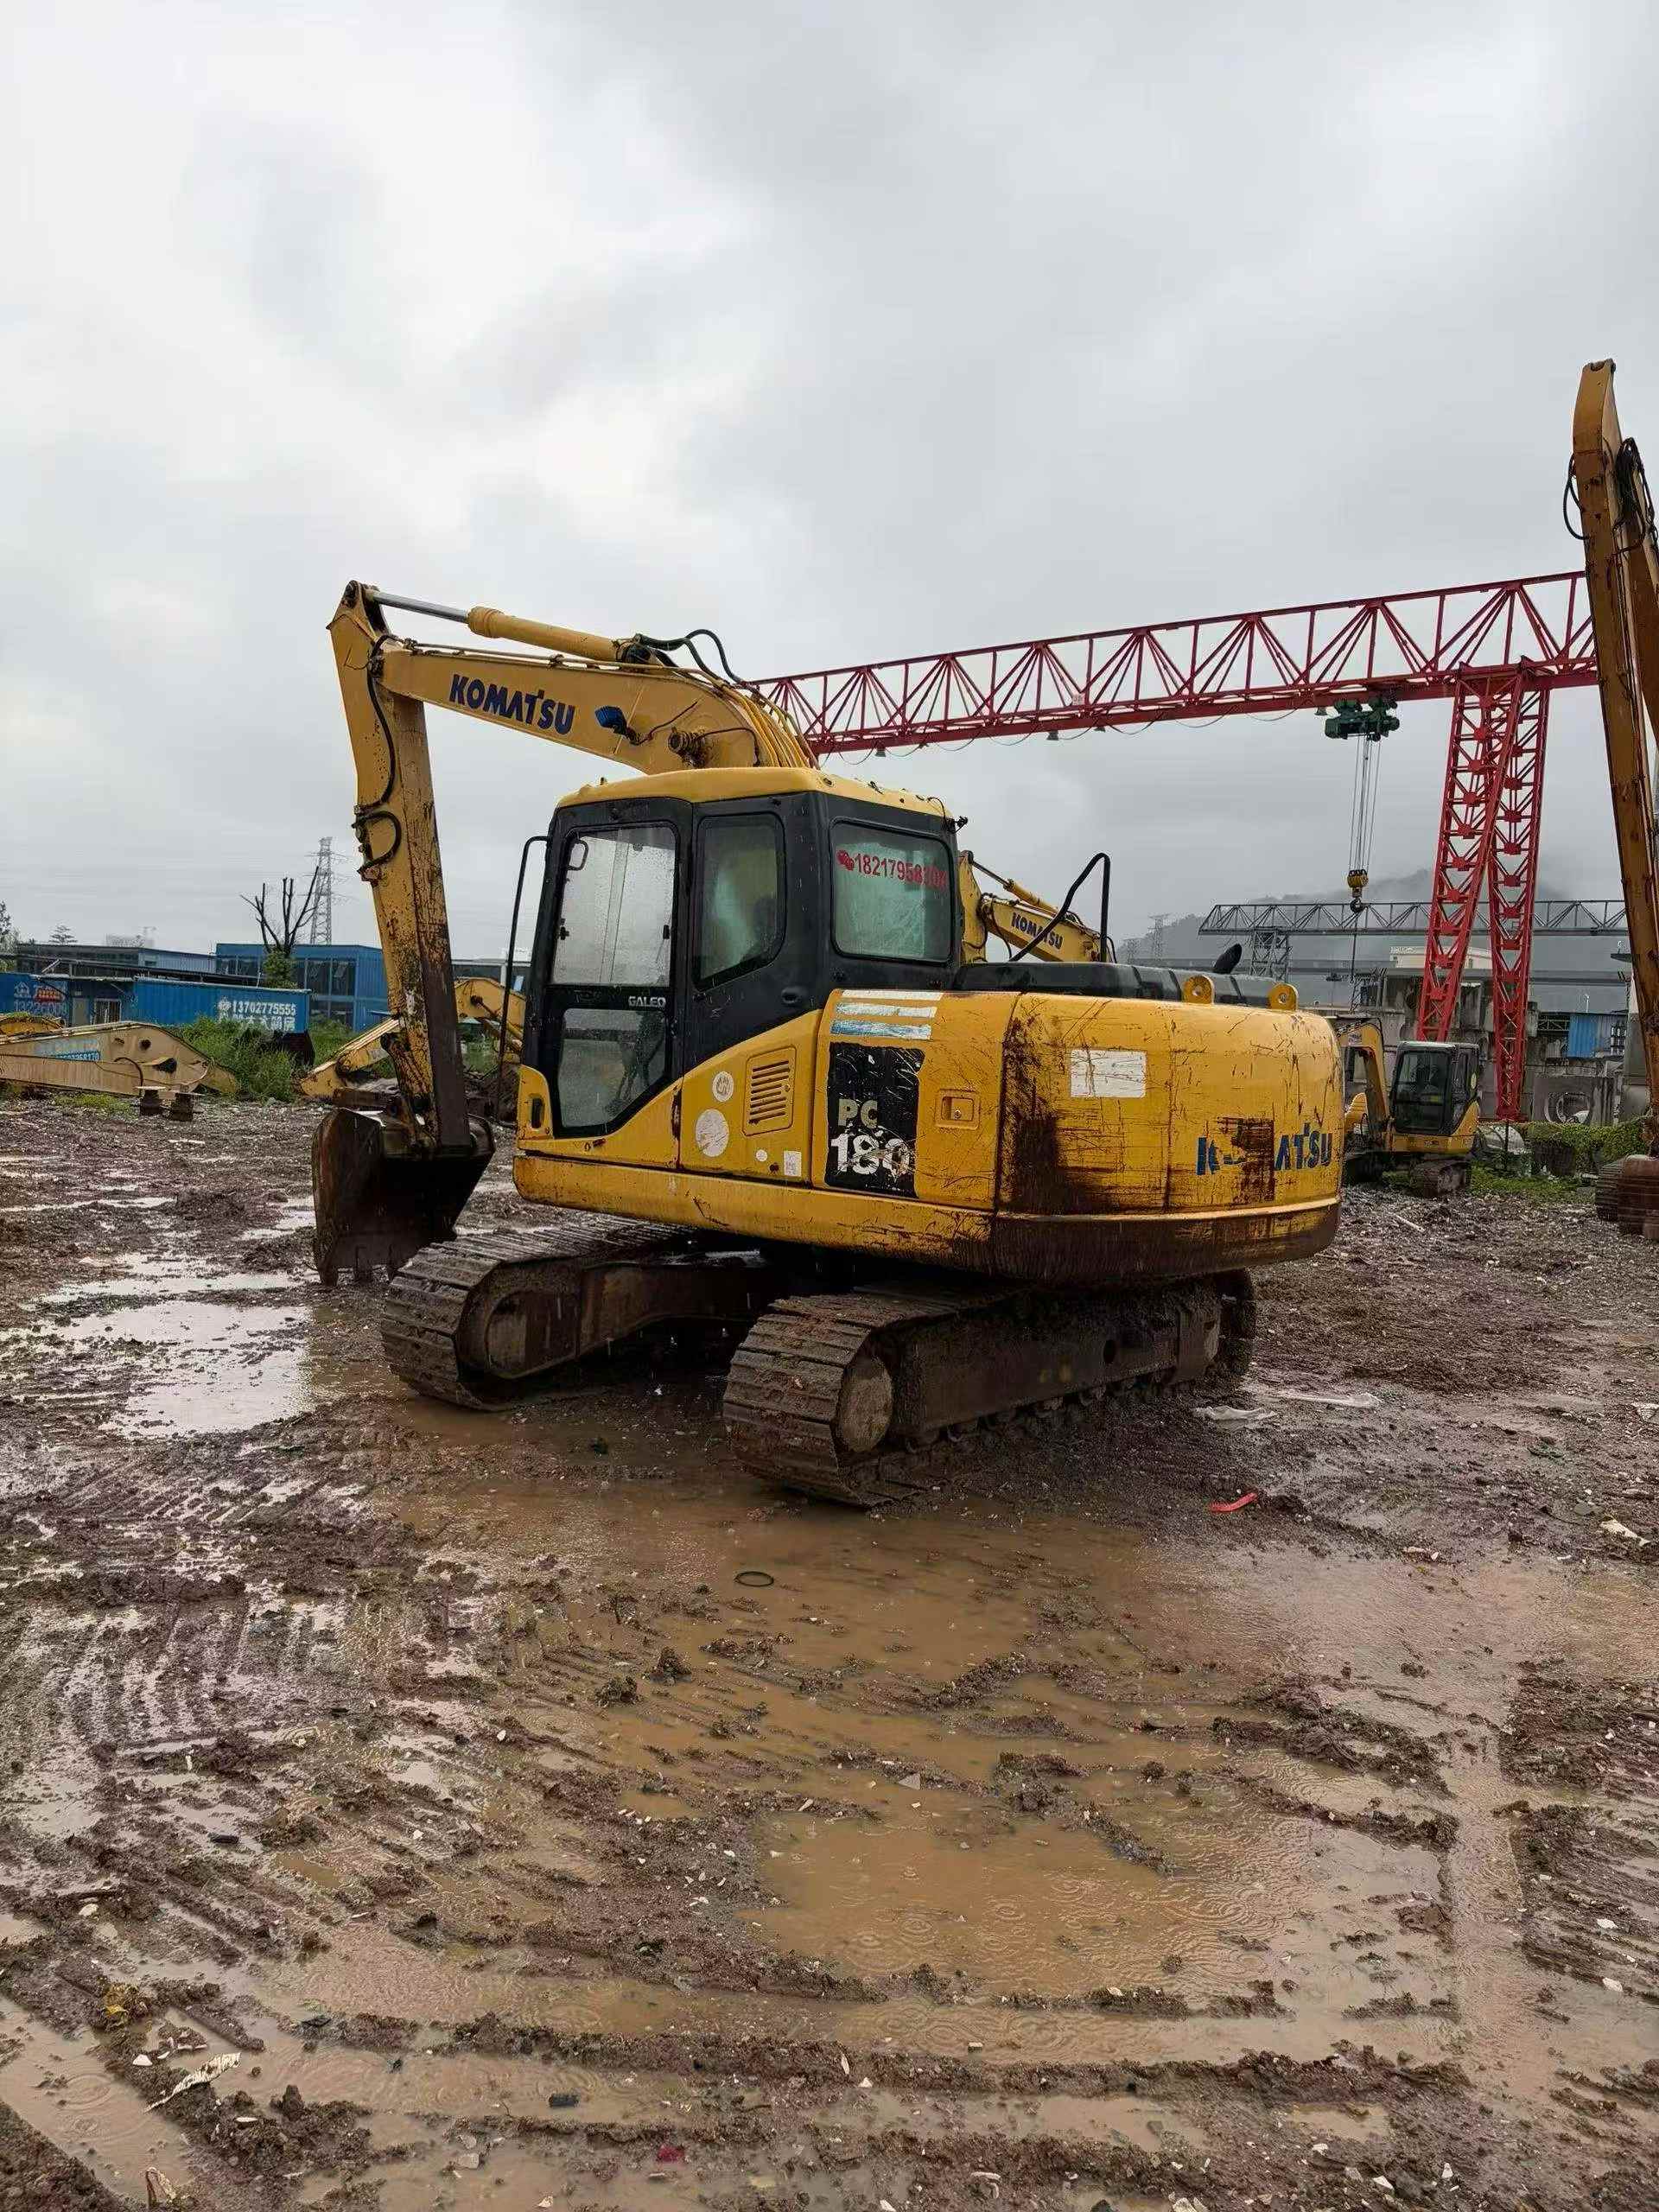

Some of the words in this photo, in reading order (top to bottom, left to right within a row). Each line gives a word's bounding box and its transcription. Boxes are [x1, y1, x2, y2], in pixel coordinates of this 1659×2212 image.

[449, 674, 575, 735] KOMATSU
[1012, 912, 1064, 950] KOMSU
[232, 1001, 296, 1015] 13702775555
[628, 995, 666, 1008] GALEO
[838, 1098, 878, 1128] PC
[1197, 1122, 1333, 1175] KATSU
